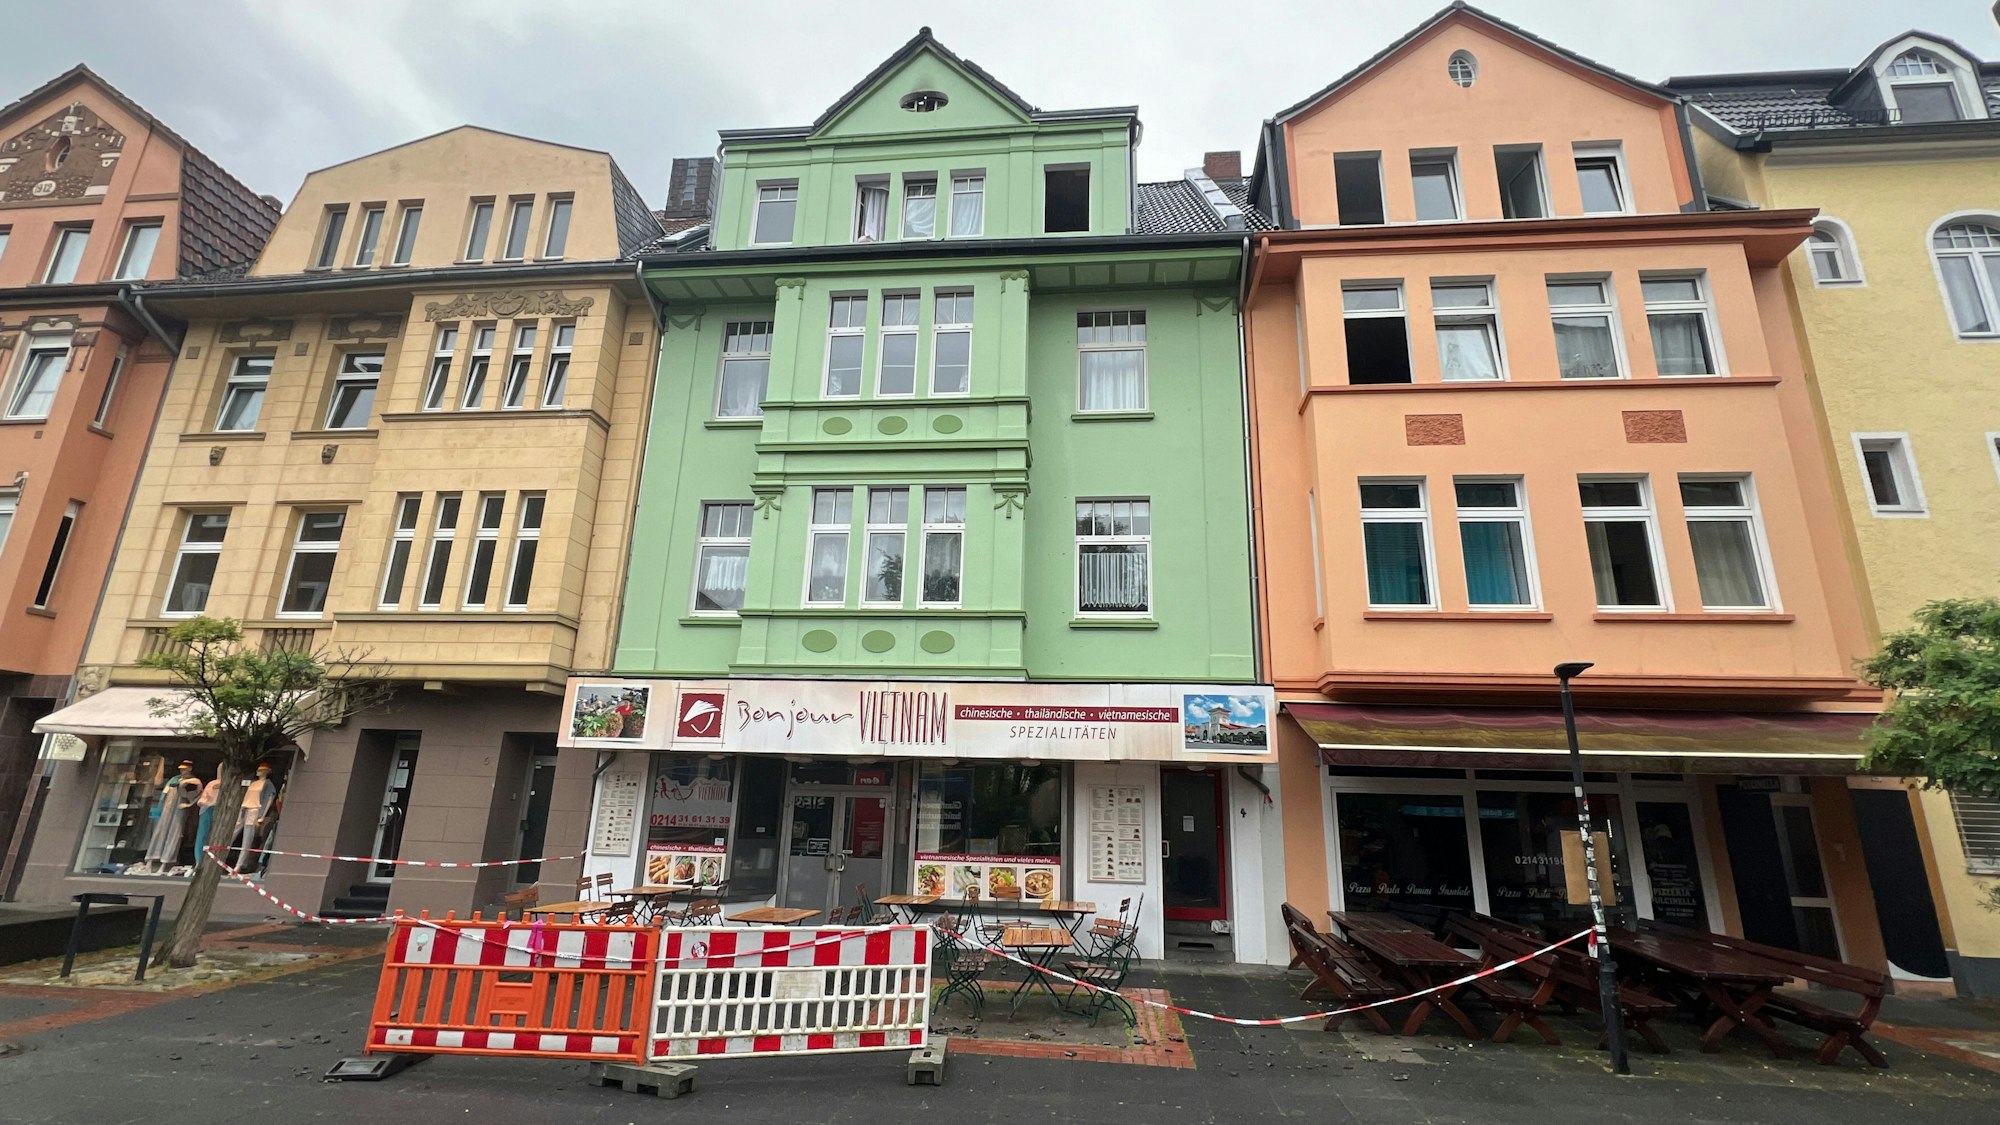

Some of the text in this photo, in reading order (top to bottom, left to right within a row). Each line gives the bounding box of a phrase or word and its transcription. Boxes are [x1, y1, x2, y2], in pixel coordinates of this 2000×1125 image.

[737, 691, 948, 744] Bonjour VIETNAM
[960, 707, 1170, 721] chinesische thailändische vietnamesische
[1009, 725, 1117, 740] SPEZIALITÄTEN
[1240, 808, 1247, 818] 4
[651, 814, 677, 826] 0214
[678, 815, 689, 823] 31
[706, 816, 717, 824] 31
[719, 816, 731, 824] 39
[965, 855, 1004, 863] Spezialitäten
[1347, 882, 1372, 894] Pizza
[1376, 883, 1400, 895] Pasta
[1496, 886, 1521, 898] Pizza
